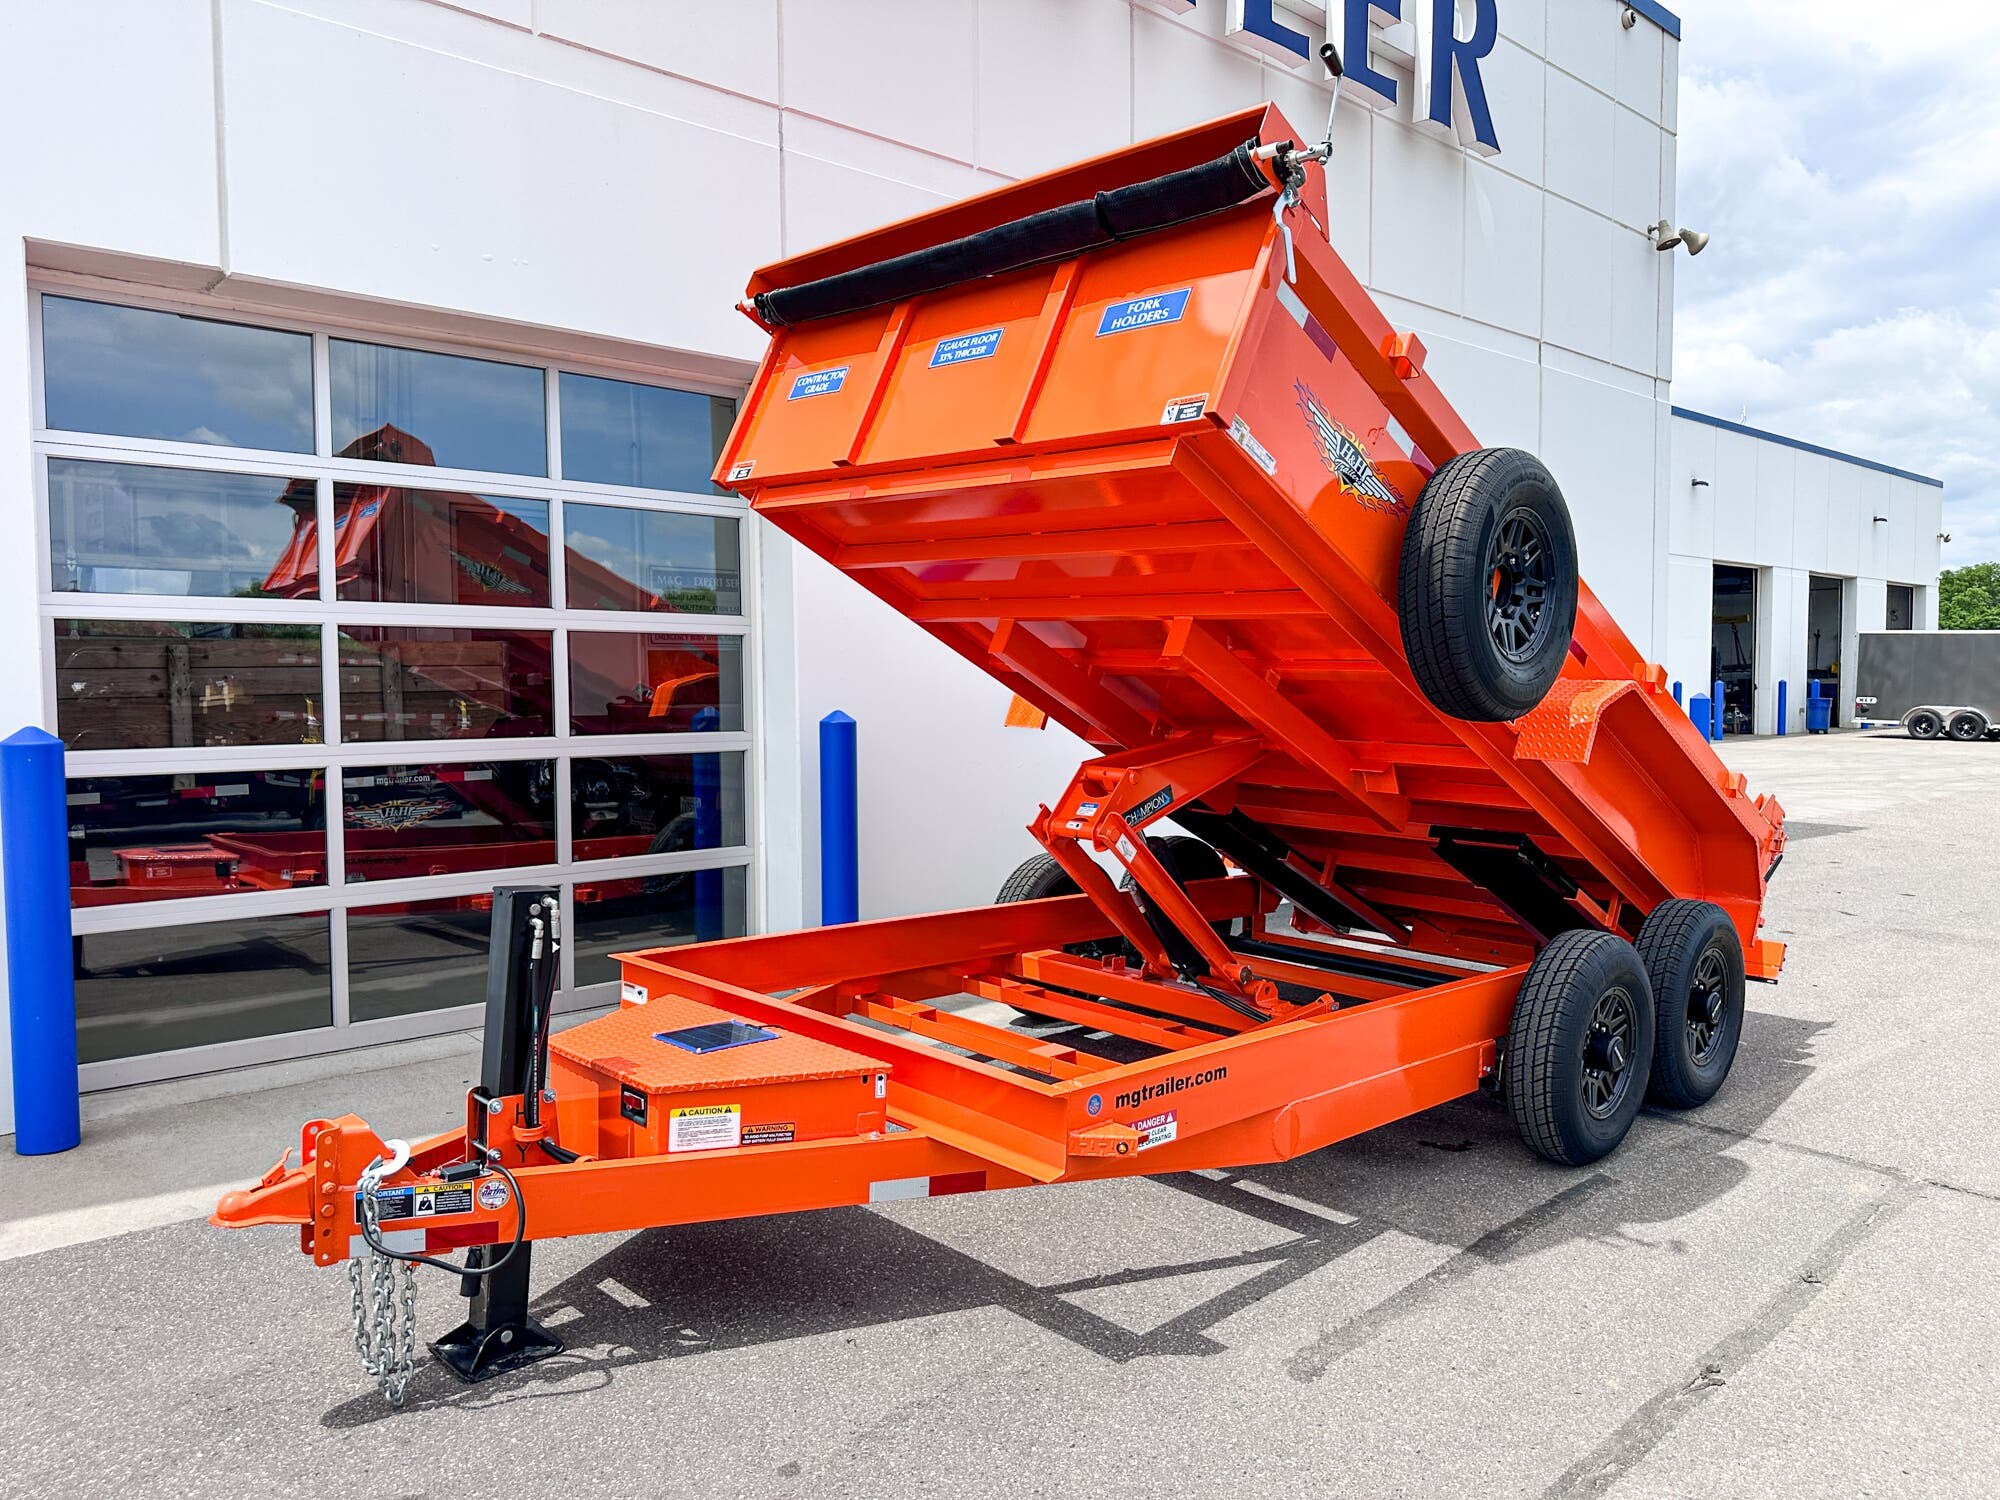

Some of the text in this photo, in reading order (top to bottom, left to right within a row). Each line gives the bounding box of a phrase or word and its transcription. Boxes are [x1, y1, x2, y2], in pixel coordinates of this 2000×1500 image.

[1126, 297, 1163, 315] FORK
[1111, 307, 1170, 330] HOLDERS
[938, 333, 998, 353] 7 GAUGE FLOOR
[938, 345, 987, 362] 33% THICKER
[797, 370, 847, 387] CONTRACTOR
[804, 382, 830, 394] GRADE
[1339, 440, 1368, 478] H&H
[376, 774, 431, 786] mgtrailer.com
[1124, 794, 1166, 826] CHAMPION
[1115, 1066, 1227, 1109] mgtrailer.com
[688, 1107, 723, 1116] CAUTION
[755, 1124, 788, 1132] WARNING
[1137, 1114, 1166, 1131] DANGER
[1151, 1126, 1167, 1136] CLEAR
[377, 1188, 406, 1197] ORTANT
[433, 1183, 464, 1192] CAUTION
